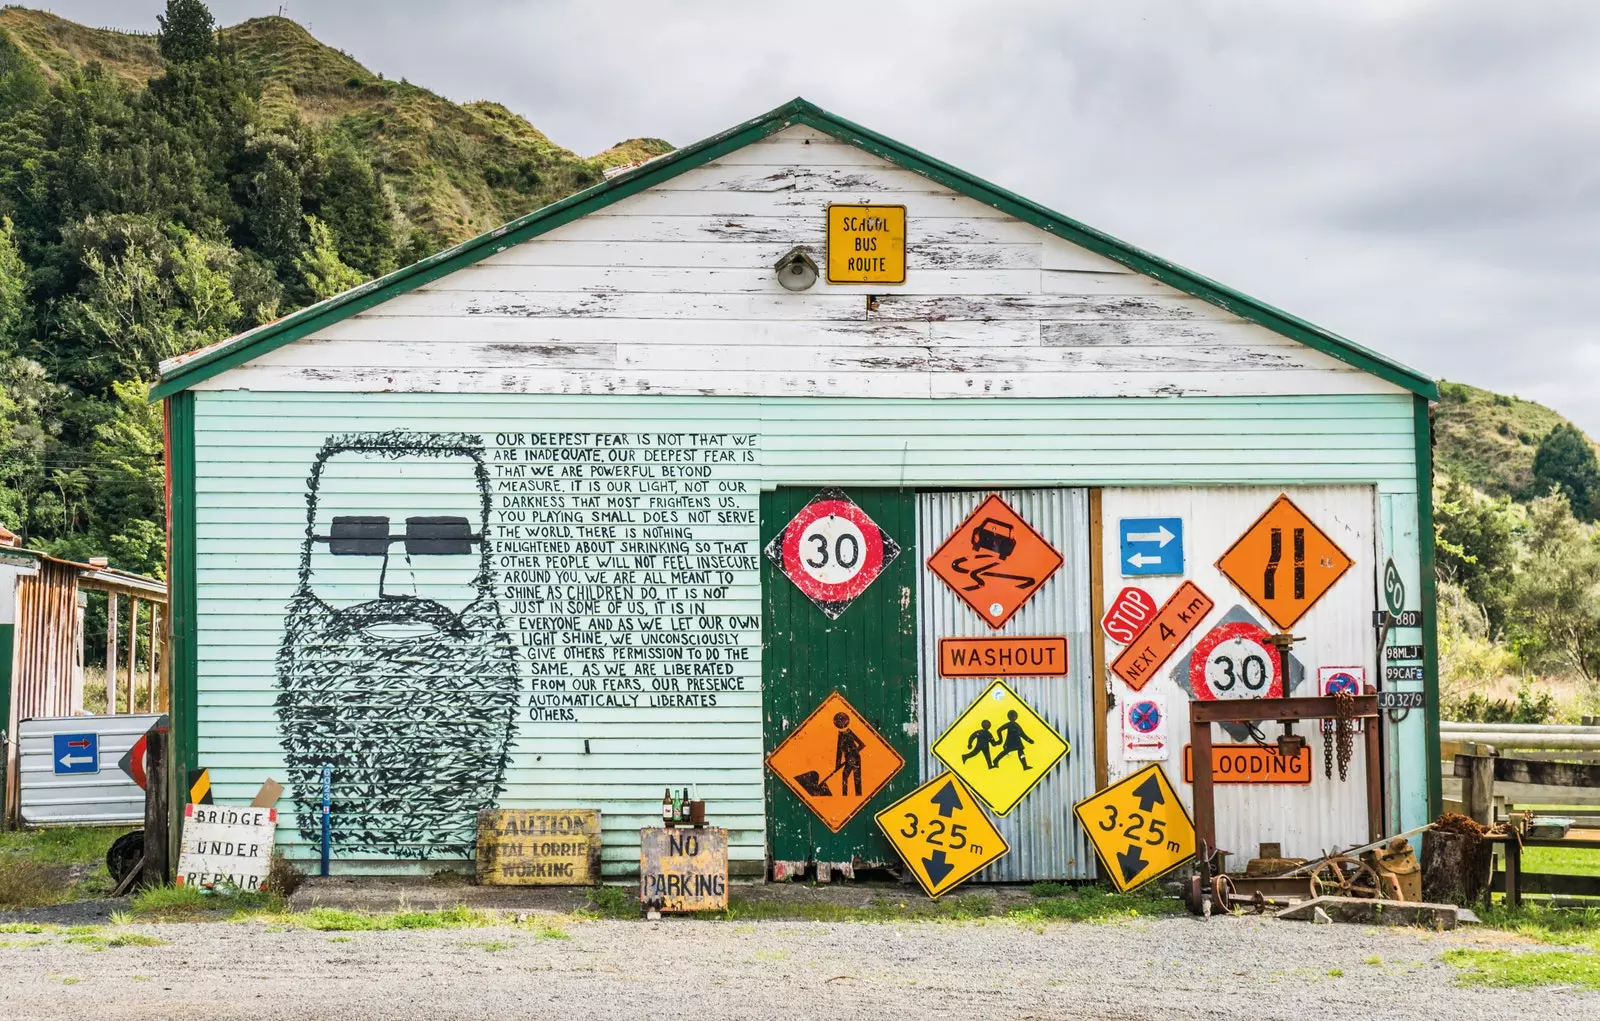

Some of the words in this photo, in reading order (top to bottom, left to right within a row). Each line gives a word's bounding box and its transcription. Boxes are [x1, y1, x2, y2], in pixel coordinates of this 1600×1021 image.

[843, 217, 890, 232] SCHOOL
[855, 237, 877, 252] BUS
[848, 257, 886, 272] ROUTE
[496, 433, 526, 445] OUR
[532, 433, 590, 445] DEEPEST
[596, 434, 629, 446] FEAR
[637, 434, 651, 445] IS
[658, 434, 685, 446] NOT
[689, 434, 728, 446] THAT
[733, 435, 757, 446] WE
[494, 449, 517, 460] ARE
[525, 449, 604, 462] INADEQUATE.
[608, 450, 636, 461] OUR
[644, 449, 698, 461] DEEPEST
[704, 451, 736, 462] FEAR
[743, 451, 755, 462] IS
[495, 465, 527, 477] THAT
[531, 465, 554, 476] WE
[561, 465, 583, 477] ARE
[591, 466, 655, 477] POWERFUL
[662, 466, 712, 477] BEYOND
[498, 480, 565, 492] MEASURE.
[571, 480, 582, 491] IT
[589, 481, 601, 492] IS
[607, 481, 632, 492] OUR
[639, 481, 678, 494] LIGHT,
[685, 481, 709, 492] NOT
[719, 481, 747, 492] OUR
[503, 496, 565, 508] DARKNESS
[572, 496, 600, 507] THAT
[608, 497, 641, 508] MOST
[650, 496, 711, 508] FRIGHTENS
[719, 497, 740, 509] US.
[498, 511, 526, 522] YOU
[533, 511, 583, 523] PLAYING
[592, 511, 636, 522] SMALL
[644, 511, 678, 523] DOES
[689, 511, 711, 523] NOT
[718, 511, 755, 523] SERVE
[497, 526, 521, 538] THE
[525, 526, 573, 538] WORLD.
[576, 526, 616, 538] THERE
[626, 528, 636, 538] IS
[644, 527, 692, 540] NOTHING
[497, 541, 570, 552] ENLIGHTENED
[576, 541, 615, 553] ABOUT
[696, 542, 710, 553] SO
[714, 542, 748, 554] THAT
[806, 533, 859, 569] 30
[501, 556, 540, 567] OTHER
[547, 556, 589, 568] PEOPLE
[596, 556, 630, 568] WILL
[635, 555, 656, 568] NOT
[663, 556, 693, 570] FEEL
[697, 556, 759, 569] INSECURE
[504, 571, 550, 583] AROUND
[555, 571, 581, 583] YOU.
[585, 571, 608, 583] WE
[613, 572, 636, 583] ARE
[644, 572, 666, 583] ALL
[671, 570, 712, 583] MEANT
[716, 571, 734, 584] TO
[547, 586, 562, 599] AS
[567, 586, 633, 600] CHILDREN
[667, 587, 678, 598] IT
[686, 588, 697, 598] IS
[704, 587, 729, 598] NOT
[1386, 566, 1403, 609] GO
[510, 601, 544, 613] JUST
[550, 602, 563, 613] IN
[567, 601, 600, 614] SOME
[608, 601, 622, 613] OF
[655, 601, 666, 614] IT
[672, 602, 684, 614] IS
[690, 602, 705, 614] IN
[1107, 590, 1150, 641] STOP
[519, 617, 581, 631] EVERYONE
[588, 618, 613, 630] AND
[618, 618, 634, 631] AS
[638, 617, 662, 630] WE
[671, 617, 693, 630] LET
[699, 617, 724, 630] OUR
[729, 616, 760, 629] OWN
[522, 631, 558, 645] LIGHT
[562, 632, 607, 646] SHINE,
[610, 633, 632, 645] WE
[641, 633, 739, 645] UNCONSCIOUSLY
[1126, 647, 1157, 680] NEXT
[1159, 622, 1176, 641] 4
[1178, 598, 1204, 623] km
[527, 648, 556, 659] GIVE
[564, 646, 605, 659] OTHERS
[613, 648, 682, 659] PERMISSION
[687, 648, 702, 659] TO
[706, 648, 720, 660] DO
[724, 648, 749, 659] THE
[951, 648, 1056, 666] WASHOUT
[532, 663, 573, 676] SAME.
[582, 663, 600, 676] AS
[604, 664, 626, 676] WE
[635, 664, 656, 676] ARE
[664, 663, 734, 675] LIBERATED
[1213, 655, 1266, 691] 30
[532, 679, 566, 691] FROM
[572, 679, 597, 691] OUR
[652, 678, 680, 691] OUR
[687, 677, 745, 691] PRESENCE
[528, 694, 639, 707] AUTOMATICALLY
[650, 694, 717, 707] LIBERATES
[1212, 755, 1302, 774] OODING
[196, 810, 263, 826] BRIDGE
[492, 815, 588, 836] CAUTION
[198, 841, 258, 857] UNDER
[670, 834, 699, 857] NO
[970, 842, 983, 855] m
[1166, 839, 1180, 853] m
[502, 862, 573, 878] WORKING
[186, 872, 258, 889] REPAIR
[644, 874, 725, 896] PARKING
